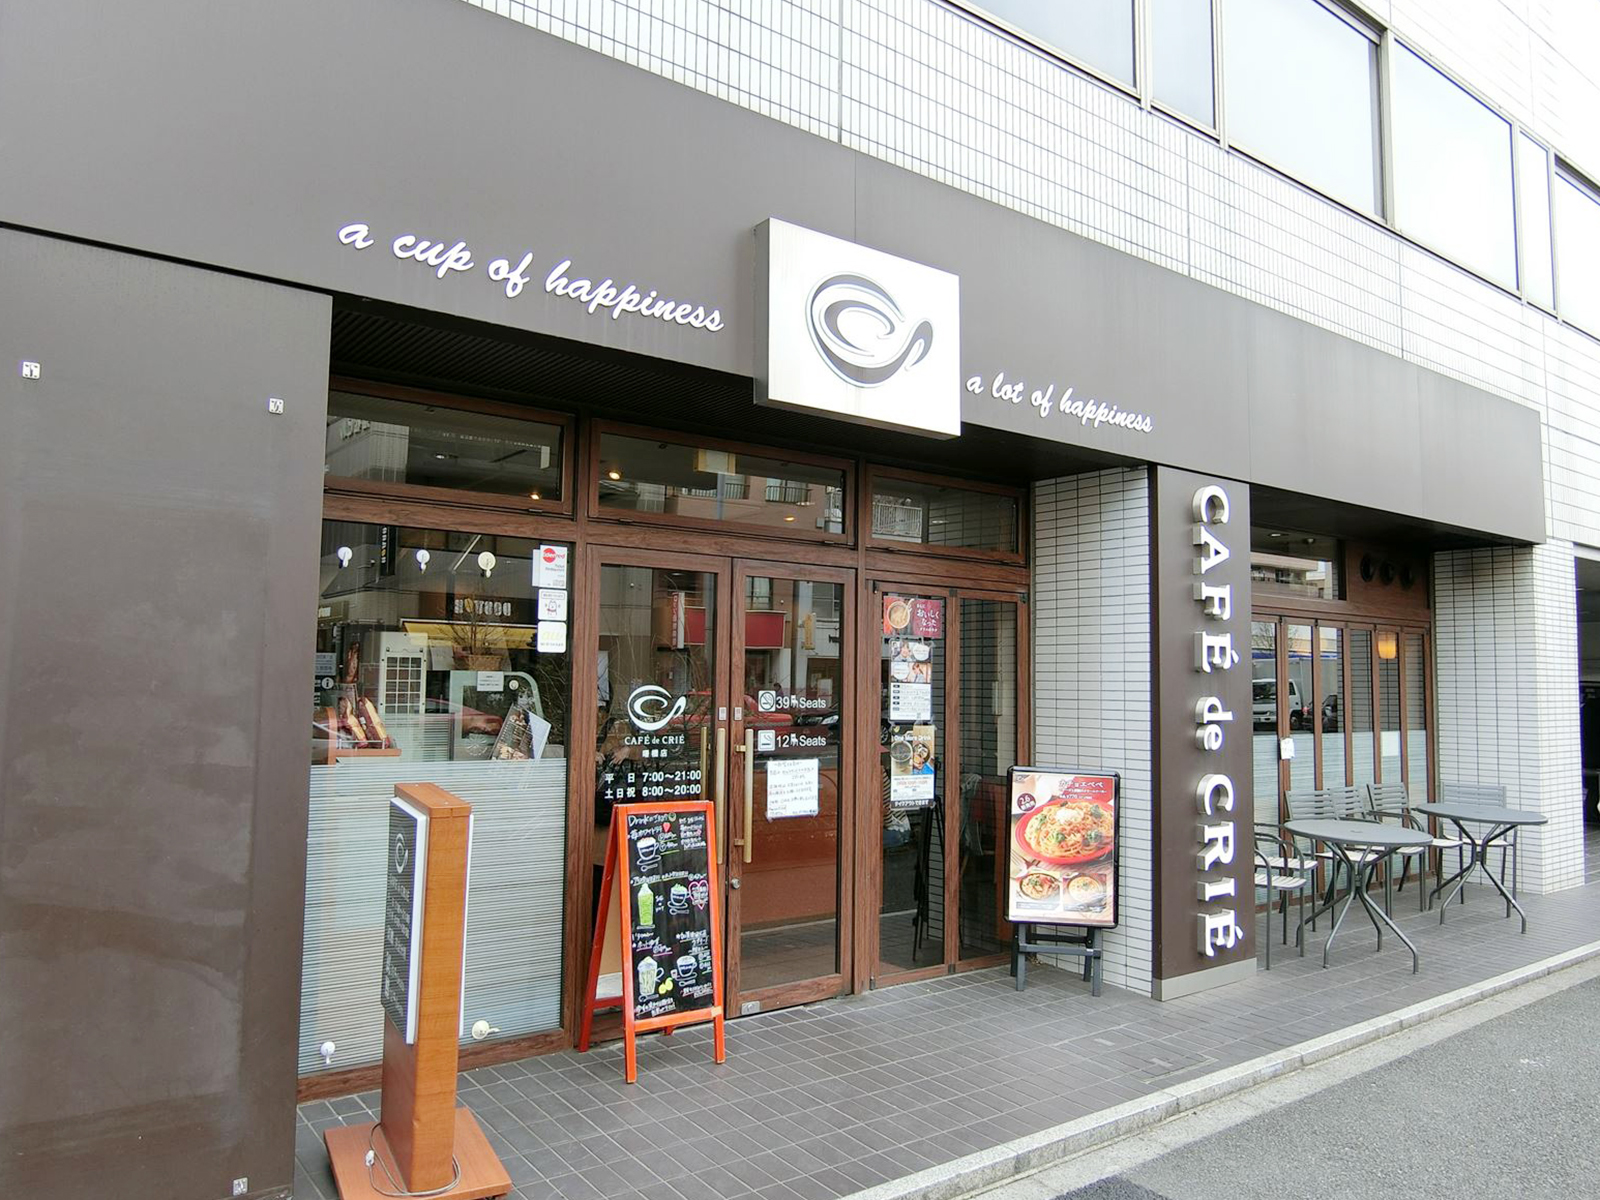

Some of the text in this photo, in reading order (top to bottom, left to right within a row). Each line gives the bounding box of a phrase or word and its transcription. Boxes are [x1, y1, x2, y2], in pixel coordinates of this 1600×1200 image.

[338, 223, 724, 332] a cup of happiness
[966, 372, 1153, 434] a lot of happiness
[776, 696, 827, 709] 39 Seats
[1192, 484, 1244, 957] CAFÉ de CRIÉ
[624, 734, 685, 745] CAFÉ de CRIÉ
[776, 735, 827, 748] 12 Seats
